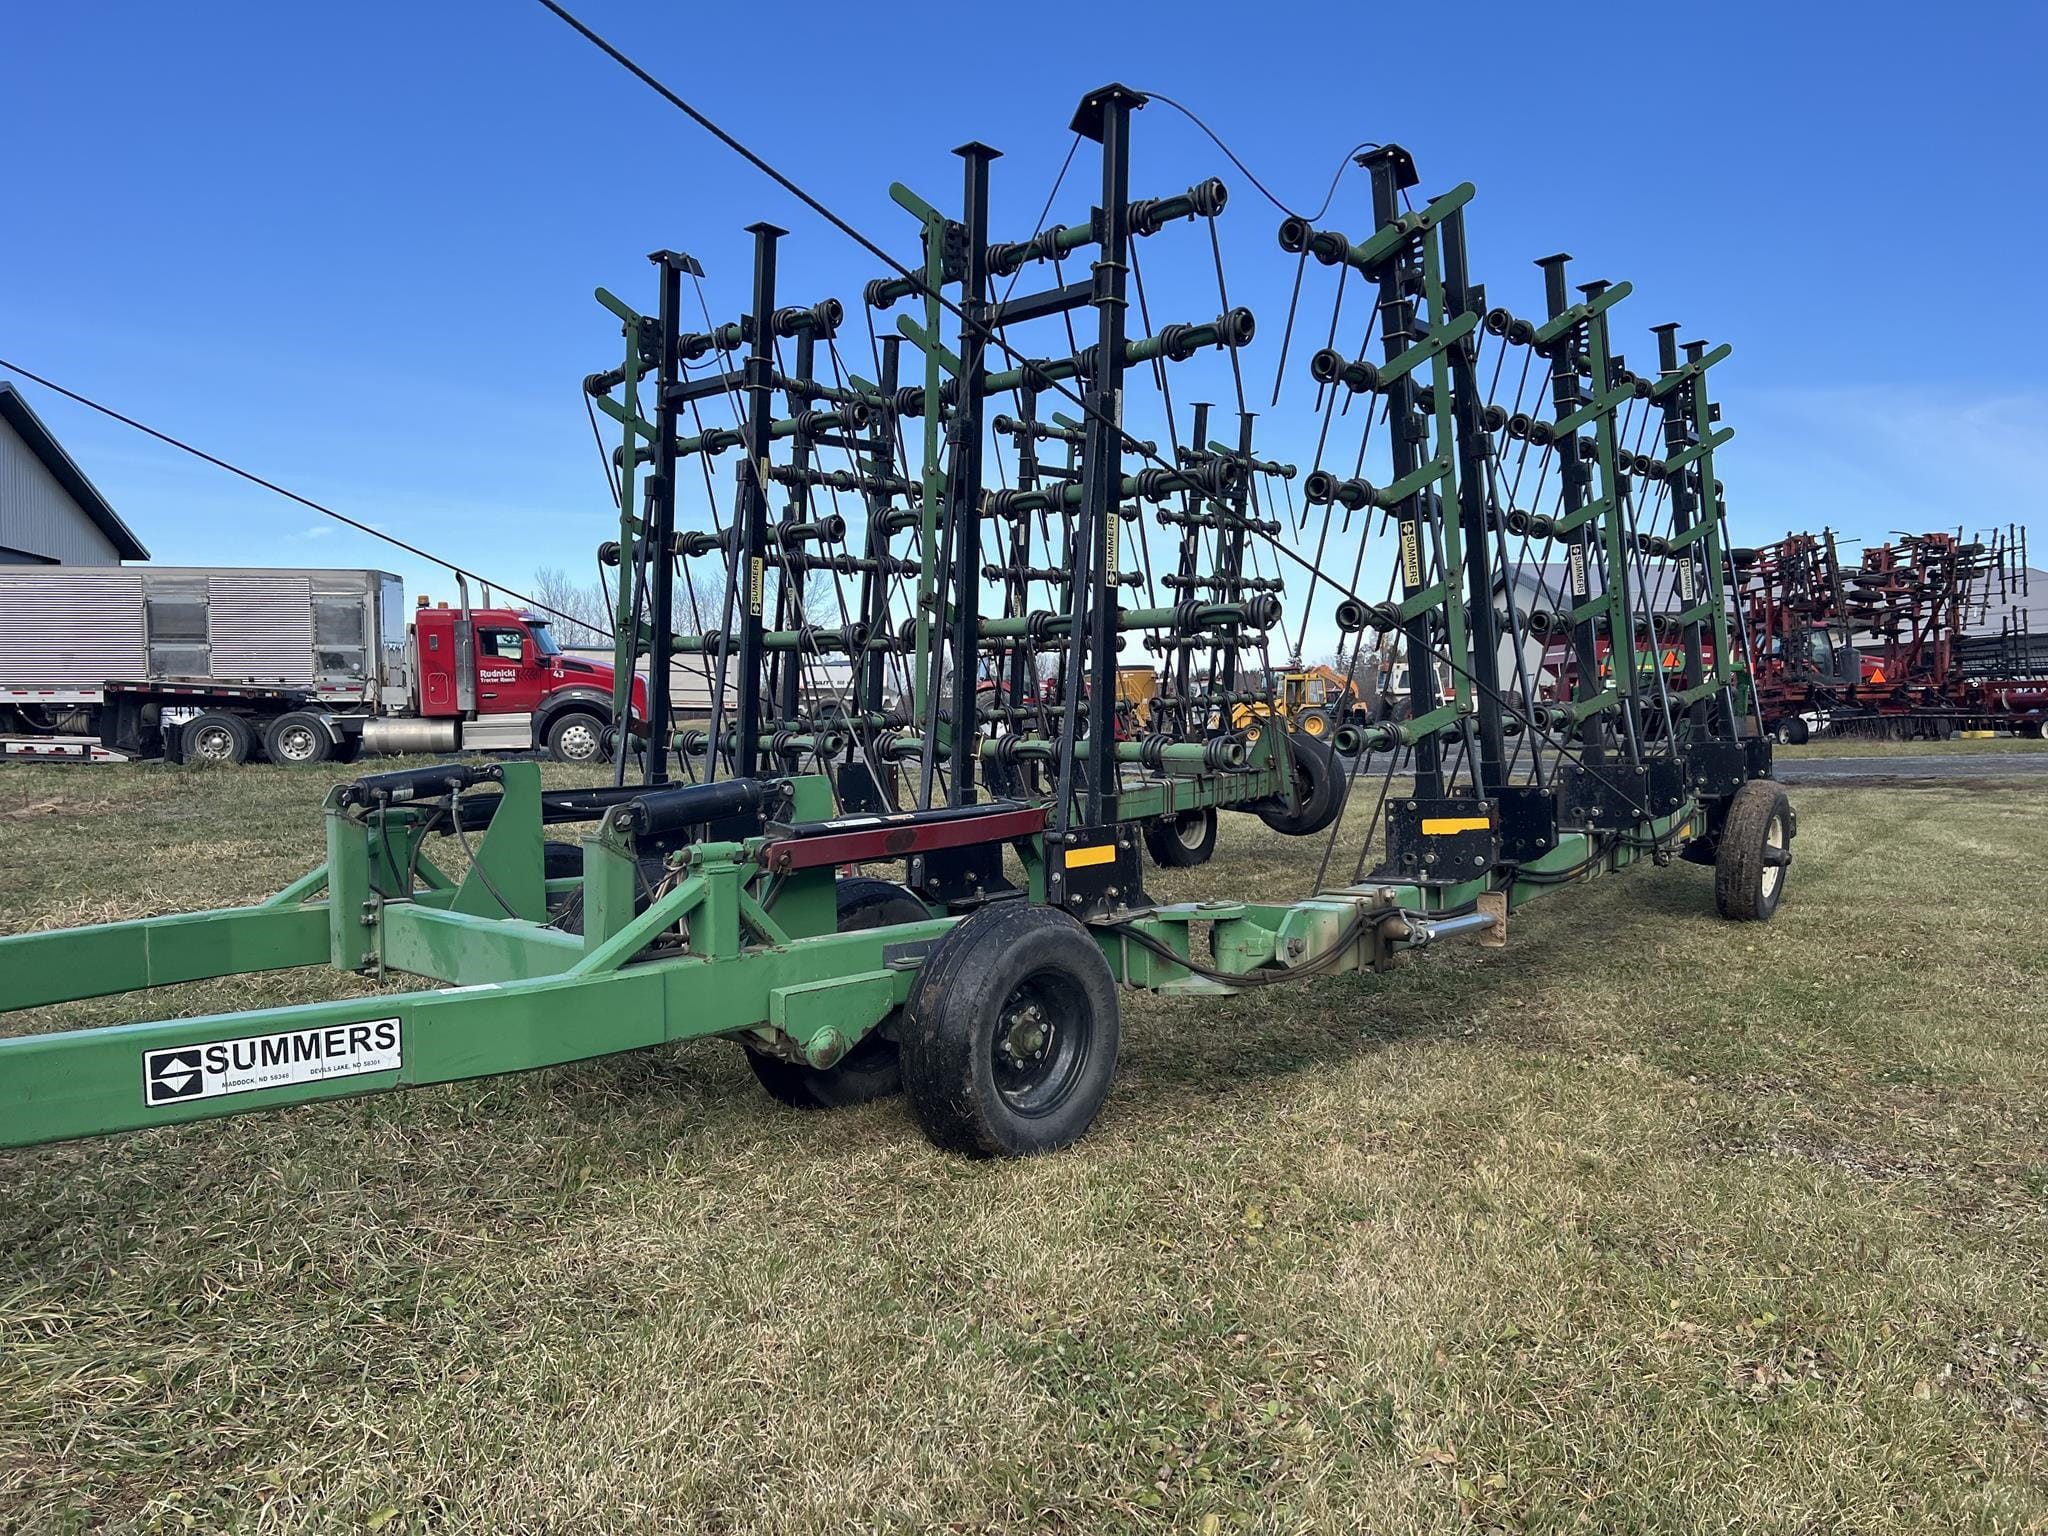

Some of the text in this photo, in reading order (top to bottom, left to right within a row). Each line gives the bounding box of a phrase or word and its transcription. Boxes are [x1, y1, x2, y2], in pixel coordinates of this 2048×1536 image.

[1107, 516, 1115, 570] SUMMERS
[1406, 536, 1418, 584] SUMMERS
[752, 559, 760, 602] SUMMERS
[1574, 555, 1585, 594] SUMMERS
[480, 669, 516, 678] Rudnicki
[552, 670, 565, 678] 43
[206, 1023, 395, 1074] SUMMERS
[258, 1075, 268, 1083] ND
[310, 1066, 332, 1075] DEVILS
